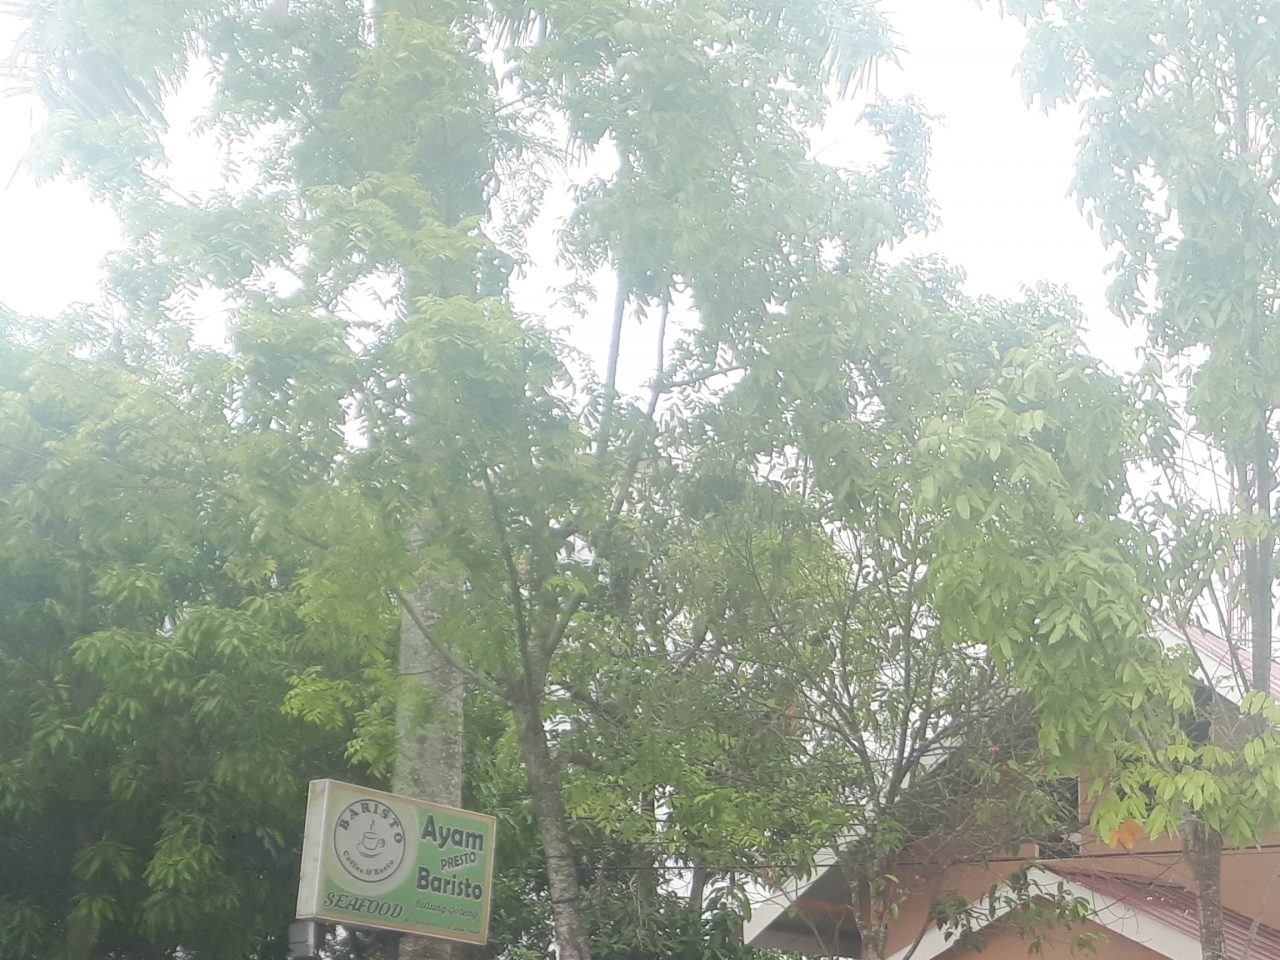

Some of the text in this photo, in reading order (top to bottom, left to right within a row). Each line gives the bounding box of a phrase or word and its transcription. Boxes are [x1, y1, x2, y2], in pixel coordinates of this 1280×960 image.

[338, 802, 403, 844] BARISTO
[421, 815, 484, 851] Ayam
[440, 851, 477, 870] PRESTO
[416, 866, 483, 900] Baristo
[323, 891, 404, 919] SEAFOOD
